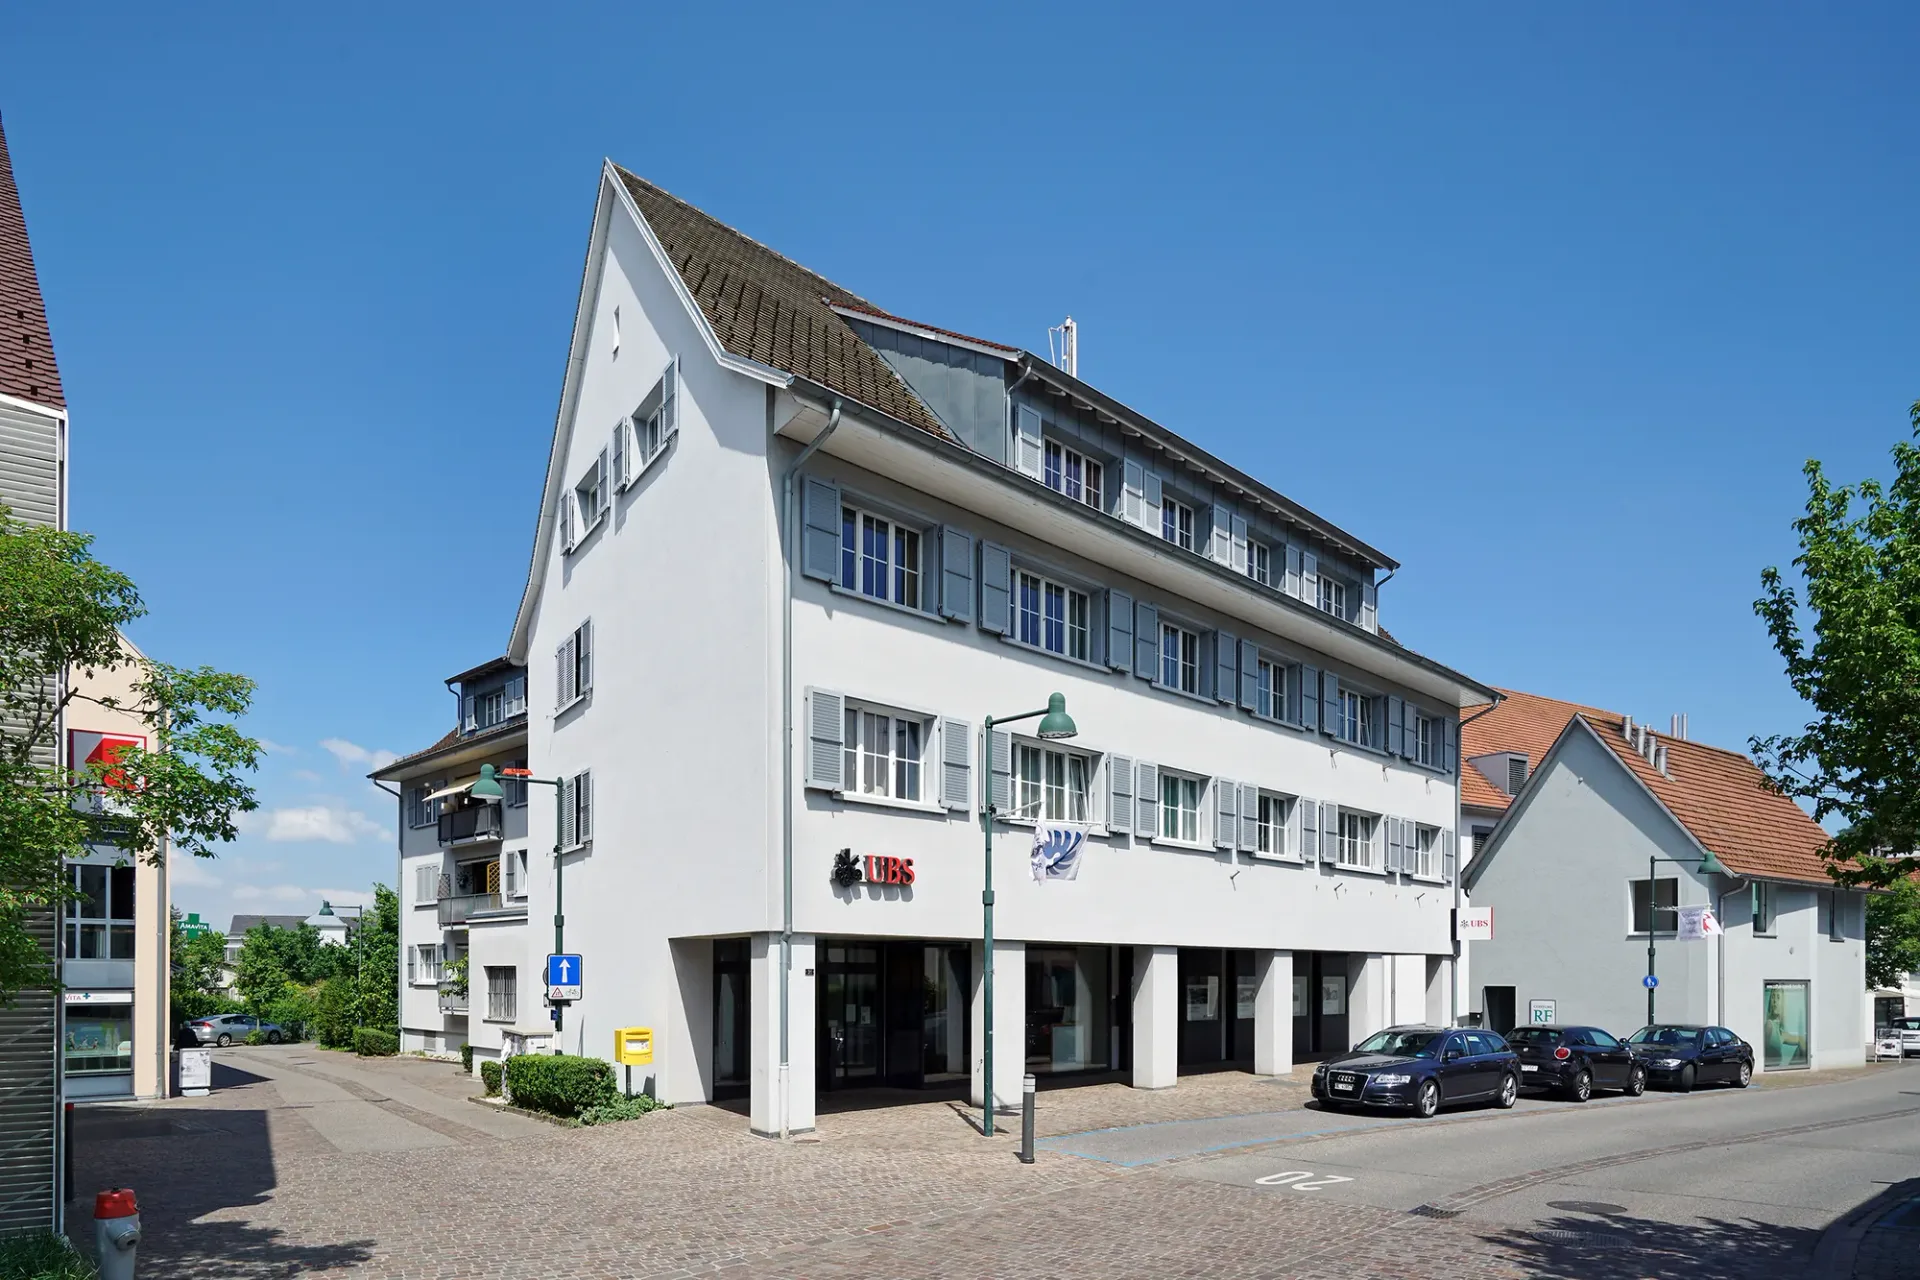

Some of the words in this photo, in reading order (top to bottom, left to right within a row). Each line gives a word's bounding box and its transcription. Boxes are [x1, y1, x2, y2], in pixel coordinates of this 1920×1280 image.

[863, 855, 915, 885] UBS
[1470, 920, 1489, 928] UBS
[1534, 1009, 1553, 1022] RF
